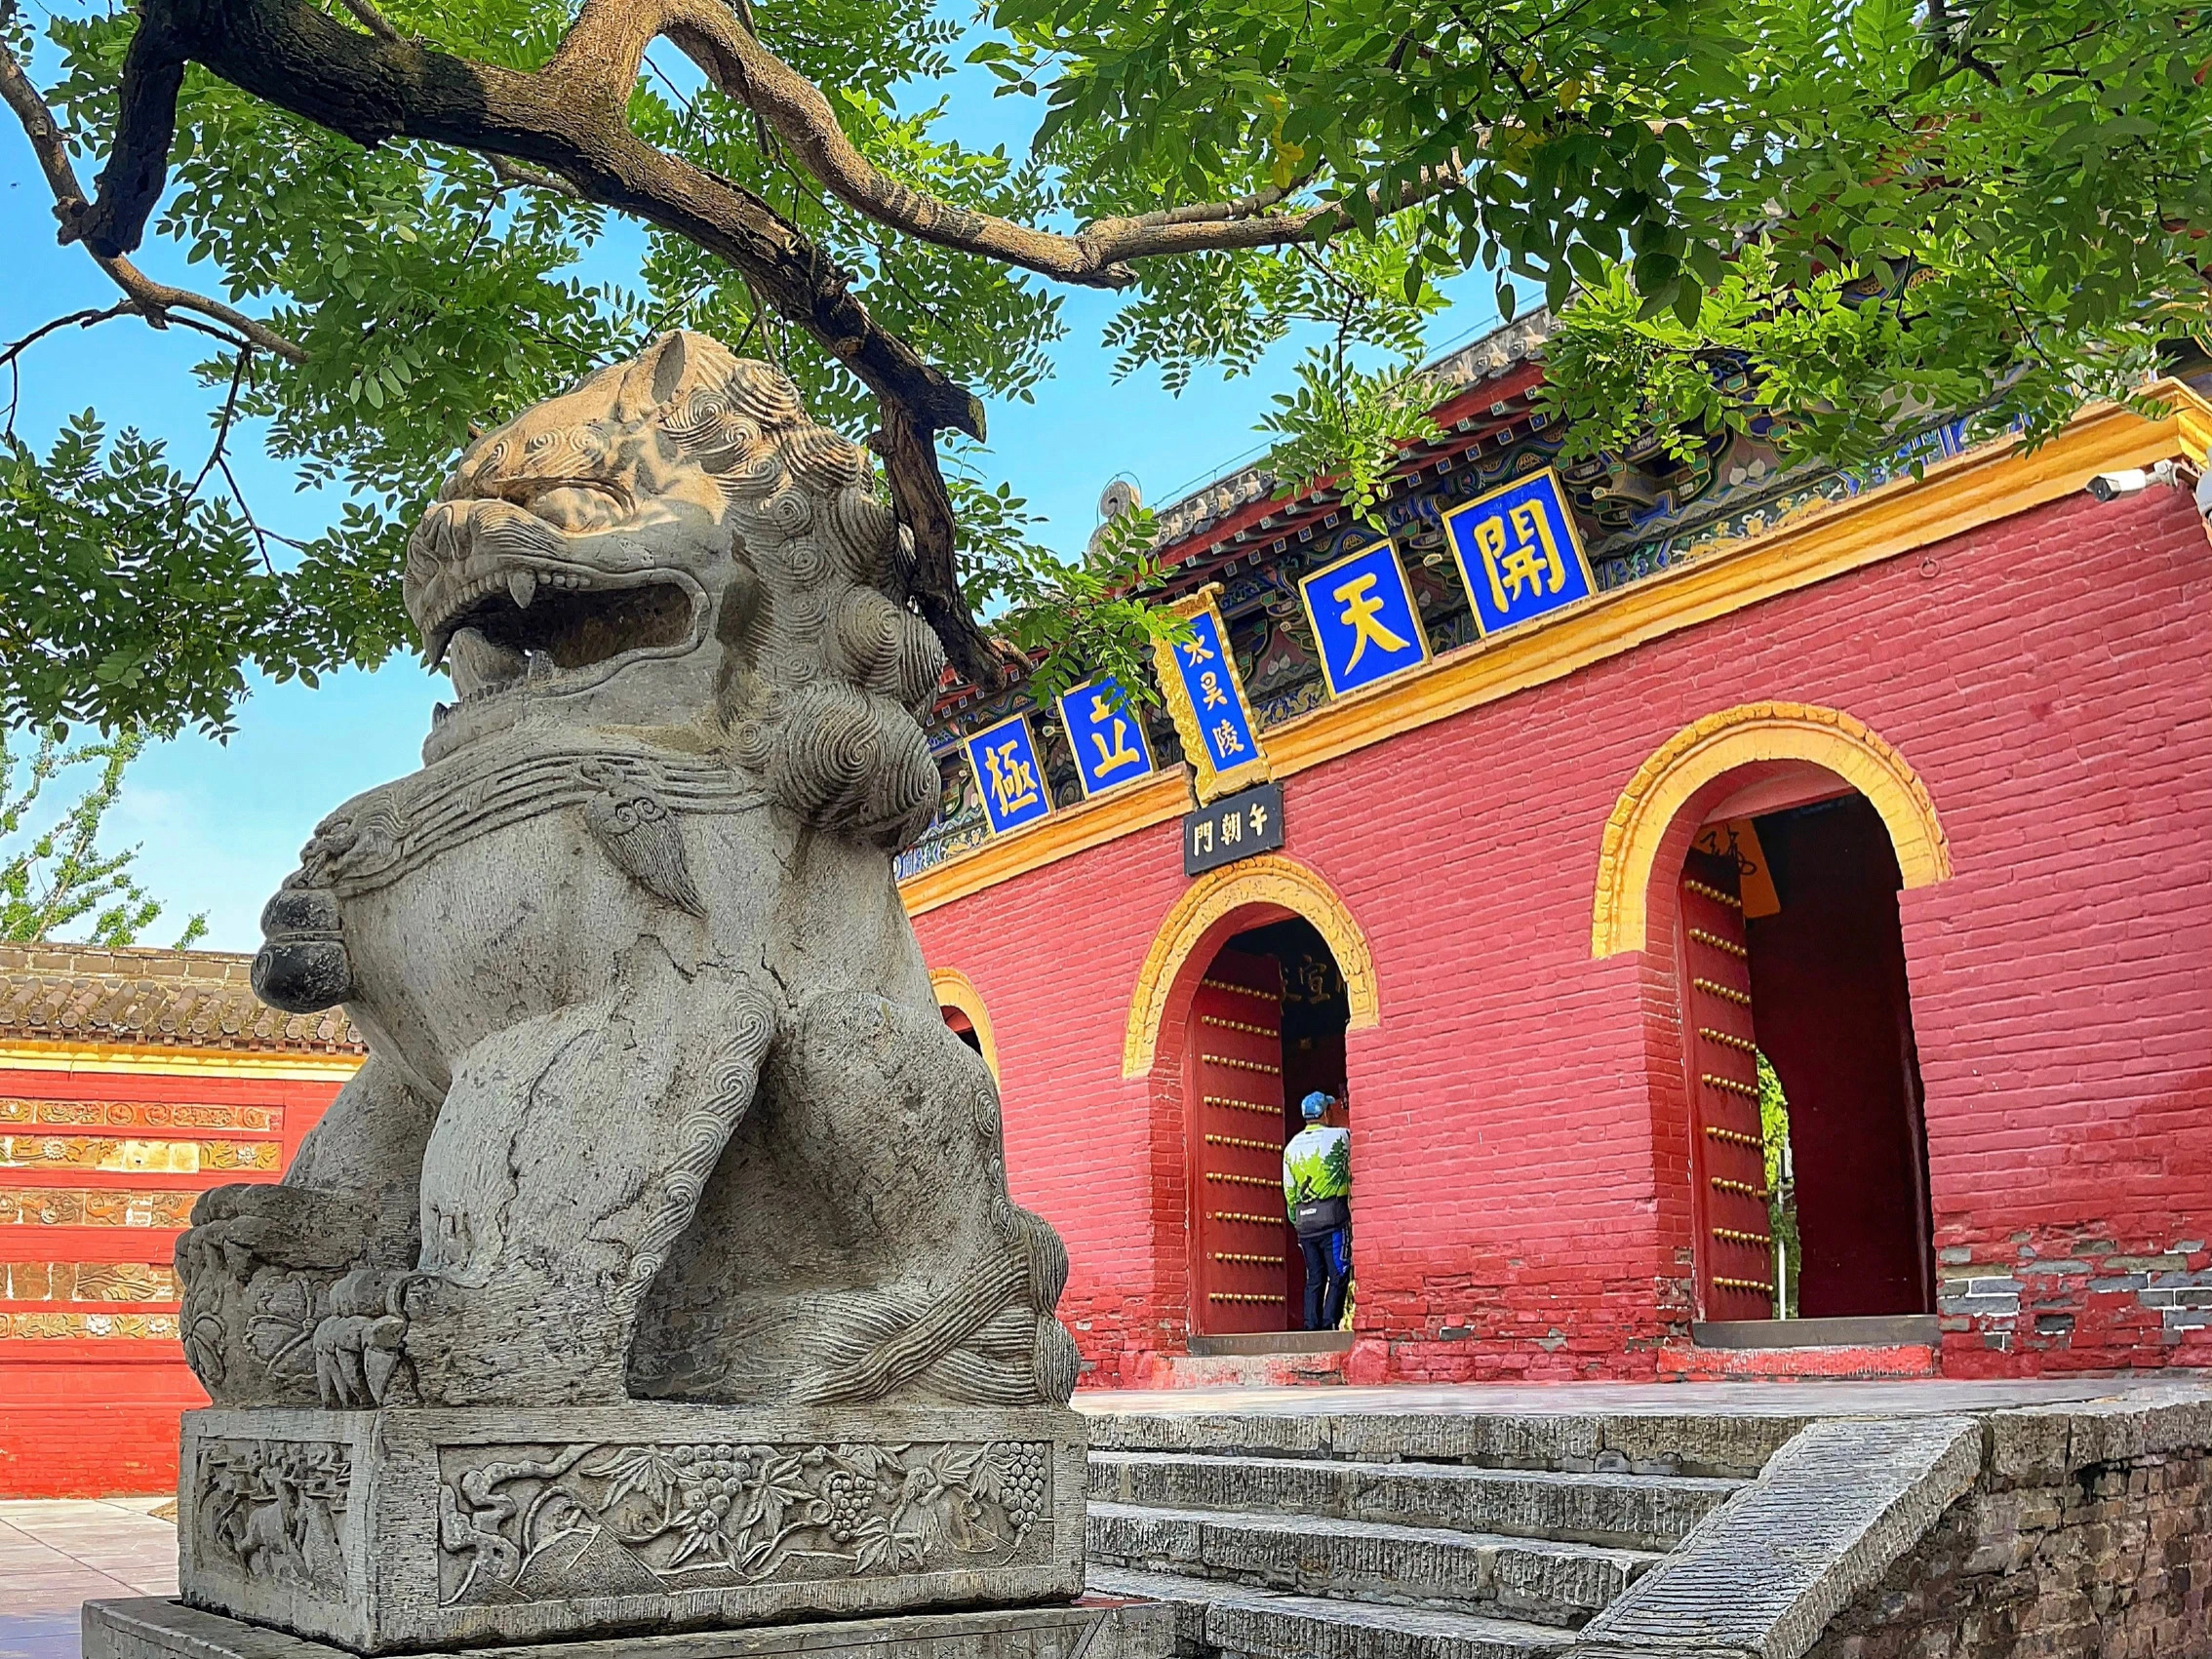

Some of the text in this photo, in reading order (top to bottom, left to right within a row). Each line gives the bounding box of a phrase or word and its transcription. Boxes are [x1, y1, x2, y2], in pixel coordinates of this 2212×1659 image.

[1473, 498, 1566, 613] 開
[1332, 572, 1411, 676] 天
[984, 739, 1039, 817] 極
[1089, 695, 1140, 778] 立
